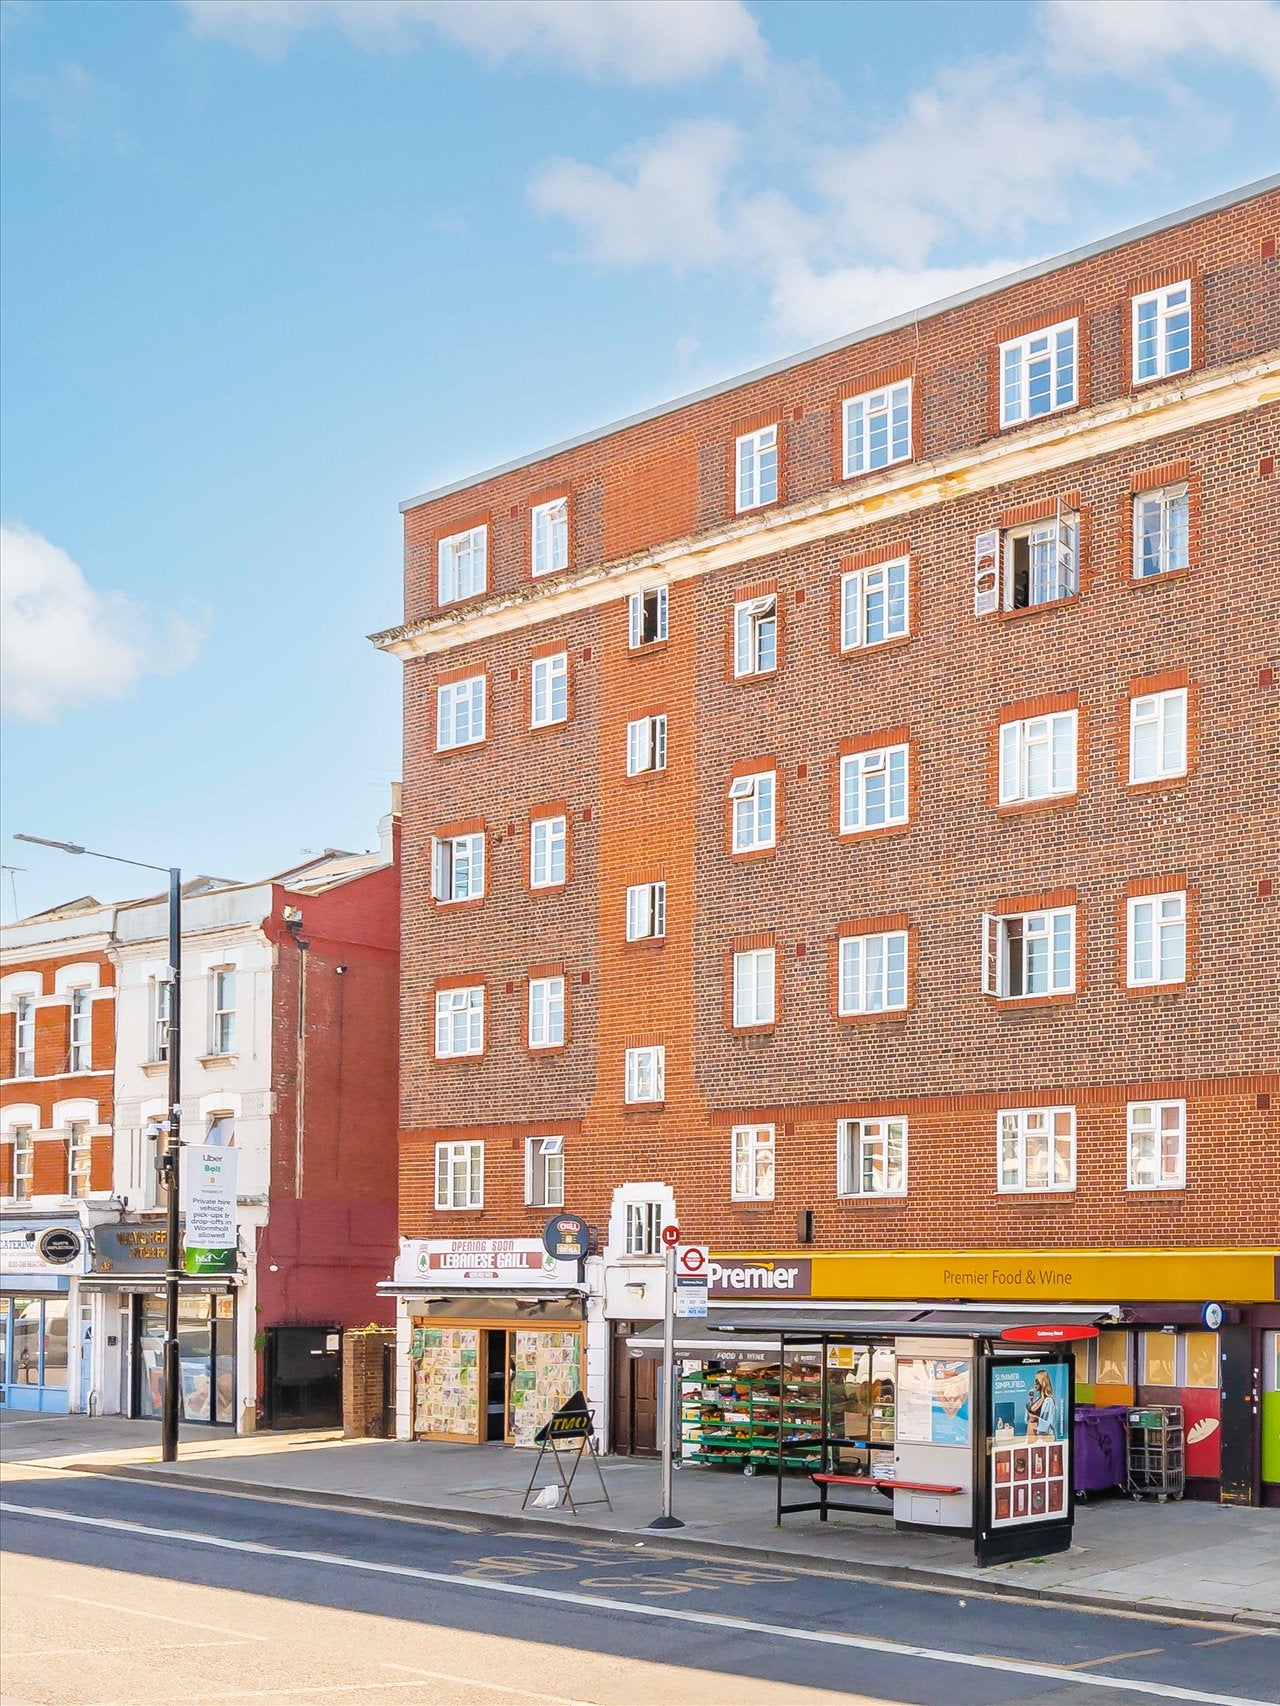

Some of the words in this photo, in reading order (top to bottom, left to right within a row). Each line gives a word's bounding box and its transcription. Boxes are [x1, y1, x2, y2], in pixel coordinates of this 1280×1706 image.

[203, 1154, 223, 1162] Uber
[204, 1164, 221, 1172] Bolt
[451, 1241, 487, 1252] OPENING
[491, 1240, 514, 1251] SOON
[440, 1253, 495, 1268] LEBANESE
[497, 1252, 529, 1268] GRILL
[707, 1262, 799, 1291] Premier
[943, 1270, 989, 1285] Premier
[992, 1269, 1021, 1285] Food
[1025, 1270, 1035, 1285] &
[1037, 1269, 1072, 1285] Wine
[746, 1353, 765, 1361] WINE
[995, 1373, 1019, 1381] SUMMER
[553, 1416, 587, 1431] TMO
